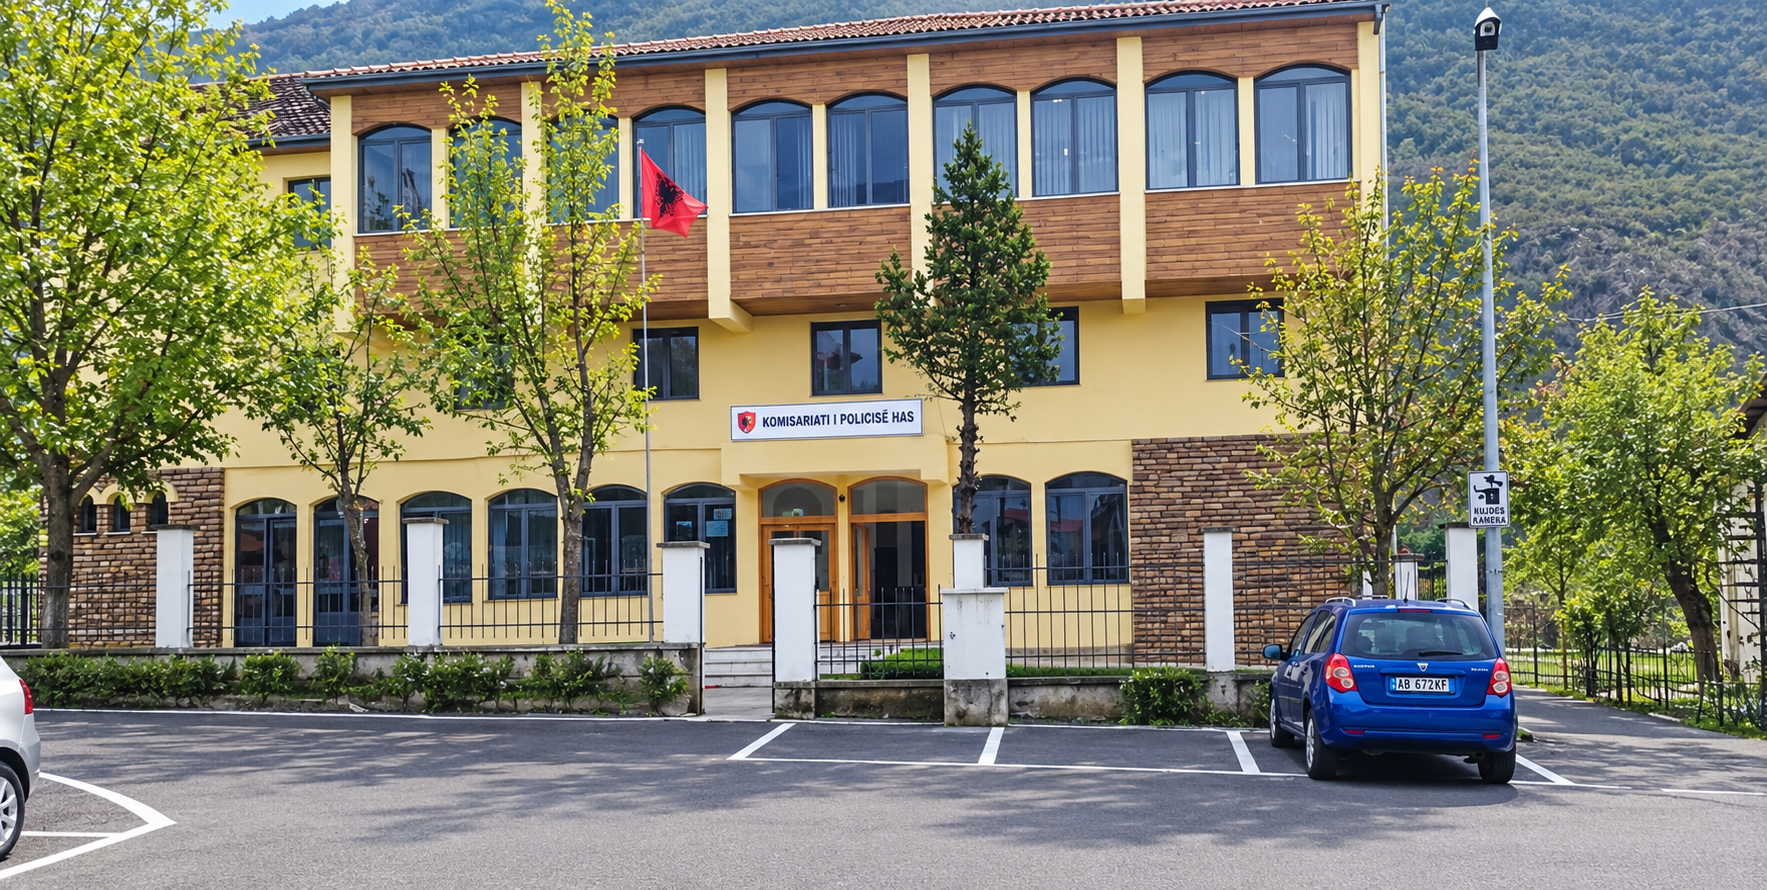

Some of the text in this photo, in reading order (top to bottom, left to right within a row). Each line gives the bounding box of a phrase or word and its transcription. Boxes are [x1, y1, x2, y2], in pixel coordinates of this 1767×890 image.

[762, 414, 830, 428] KOMISARIATI
[833, 413, 837, 426] I
[892, 410, 915, 423] HAS
[1397, 678, 1447, 691] AB 672KF
